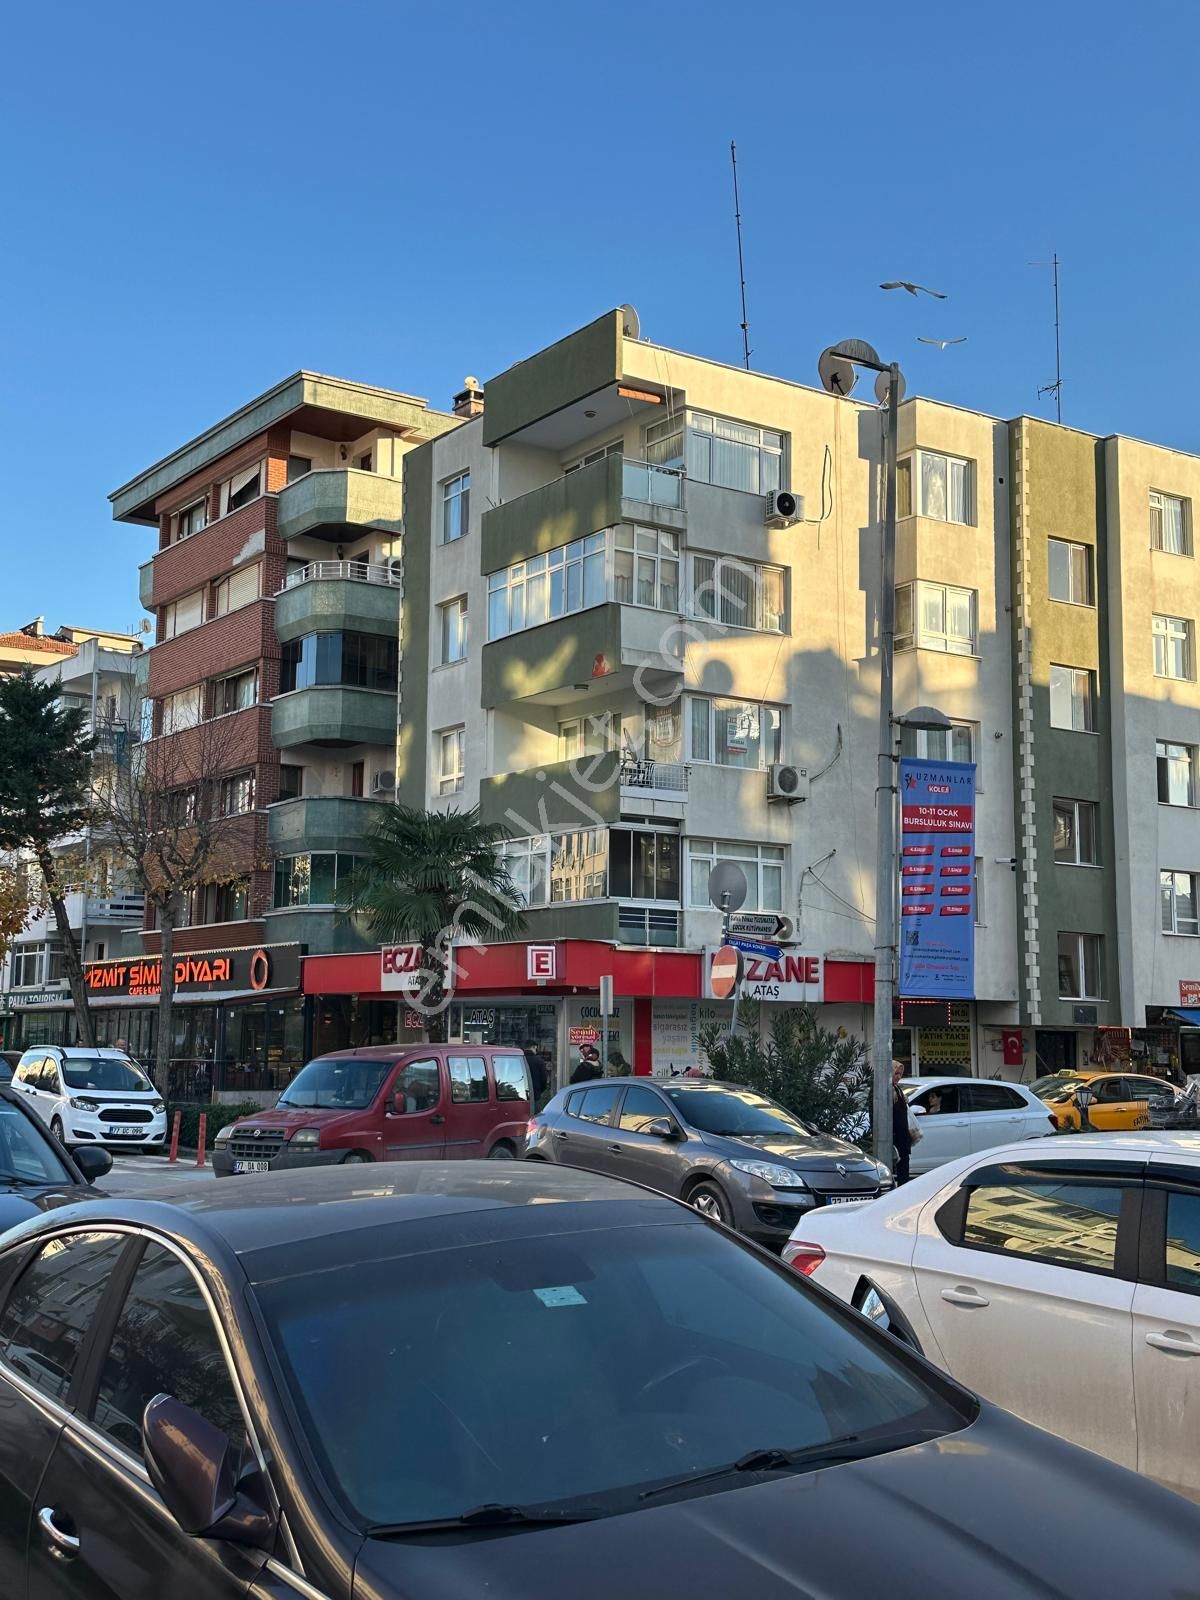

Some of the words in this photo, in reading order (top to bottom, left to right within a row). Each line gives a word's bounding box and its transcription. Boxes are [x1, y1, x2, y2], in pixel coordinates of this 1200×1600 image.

[916, 772, 972, 784] UZMANLAR
[918, 807, 935, 816] 10-11
[937, 808, 958, 817] OCAK
[904, 817, 947, 827] BURSLULUK
[948, 820, 973, 830] SINAVI
[90, 964, 127, 989] İZMİT
[129, 959, 162, 986] SİMİ
[175, 956, 230, 983] DİYARI
[753, 985, 780, 999] ATAŞ
[470, 1008, 496, 1029] ATAŞ
[699, 1007, 716, 1019] kilo
[653, 1022, 688, 1033] sigarasız
